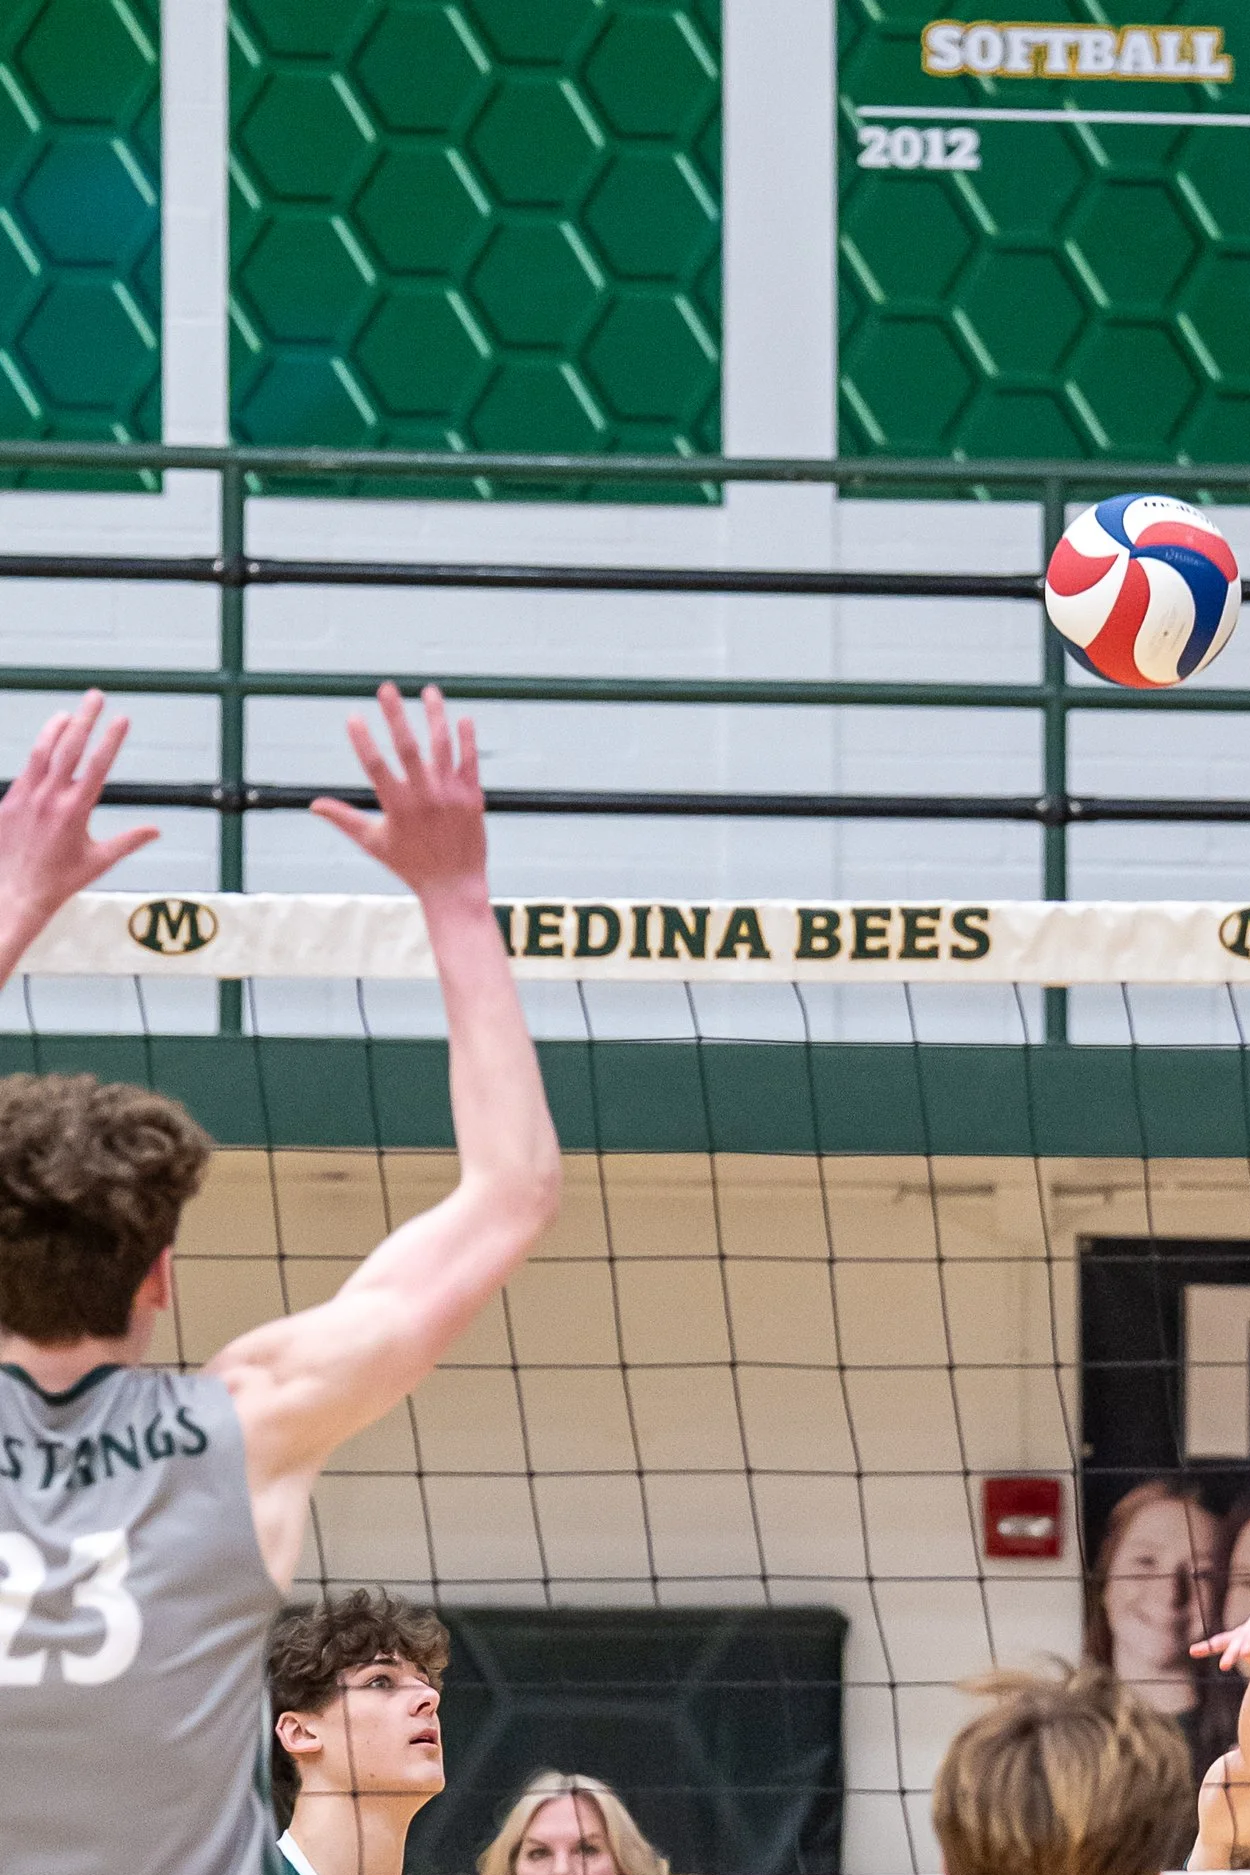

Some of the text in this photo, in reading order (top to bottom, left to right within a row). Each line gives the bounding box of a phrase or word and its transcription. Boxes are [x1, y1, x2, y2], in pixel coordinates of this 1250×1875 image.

[922, 20, 1233, 83] SOFTBALL
[857, 125, 982, 171] 2012
[138, 899, 210, 954] M
[795, 905, 991, 962] BEES
